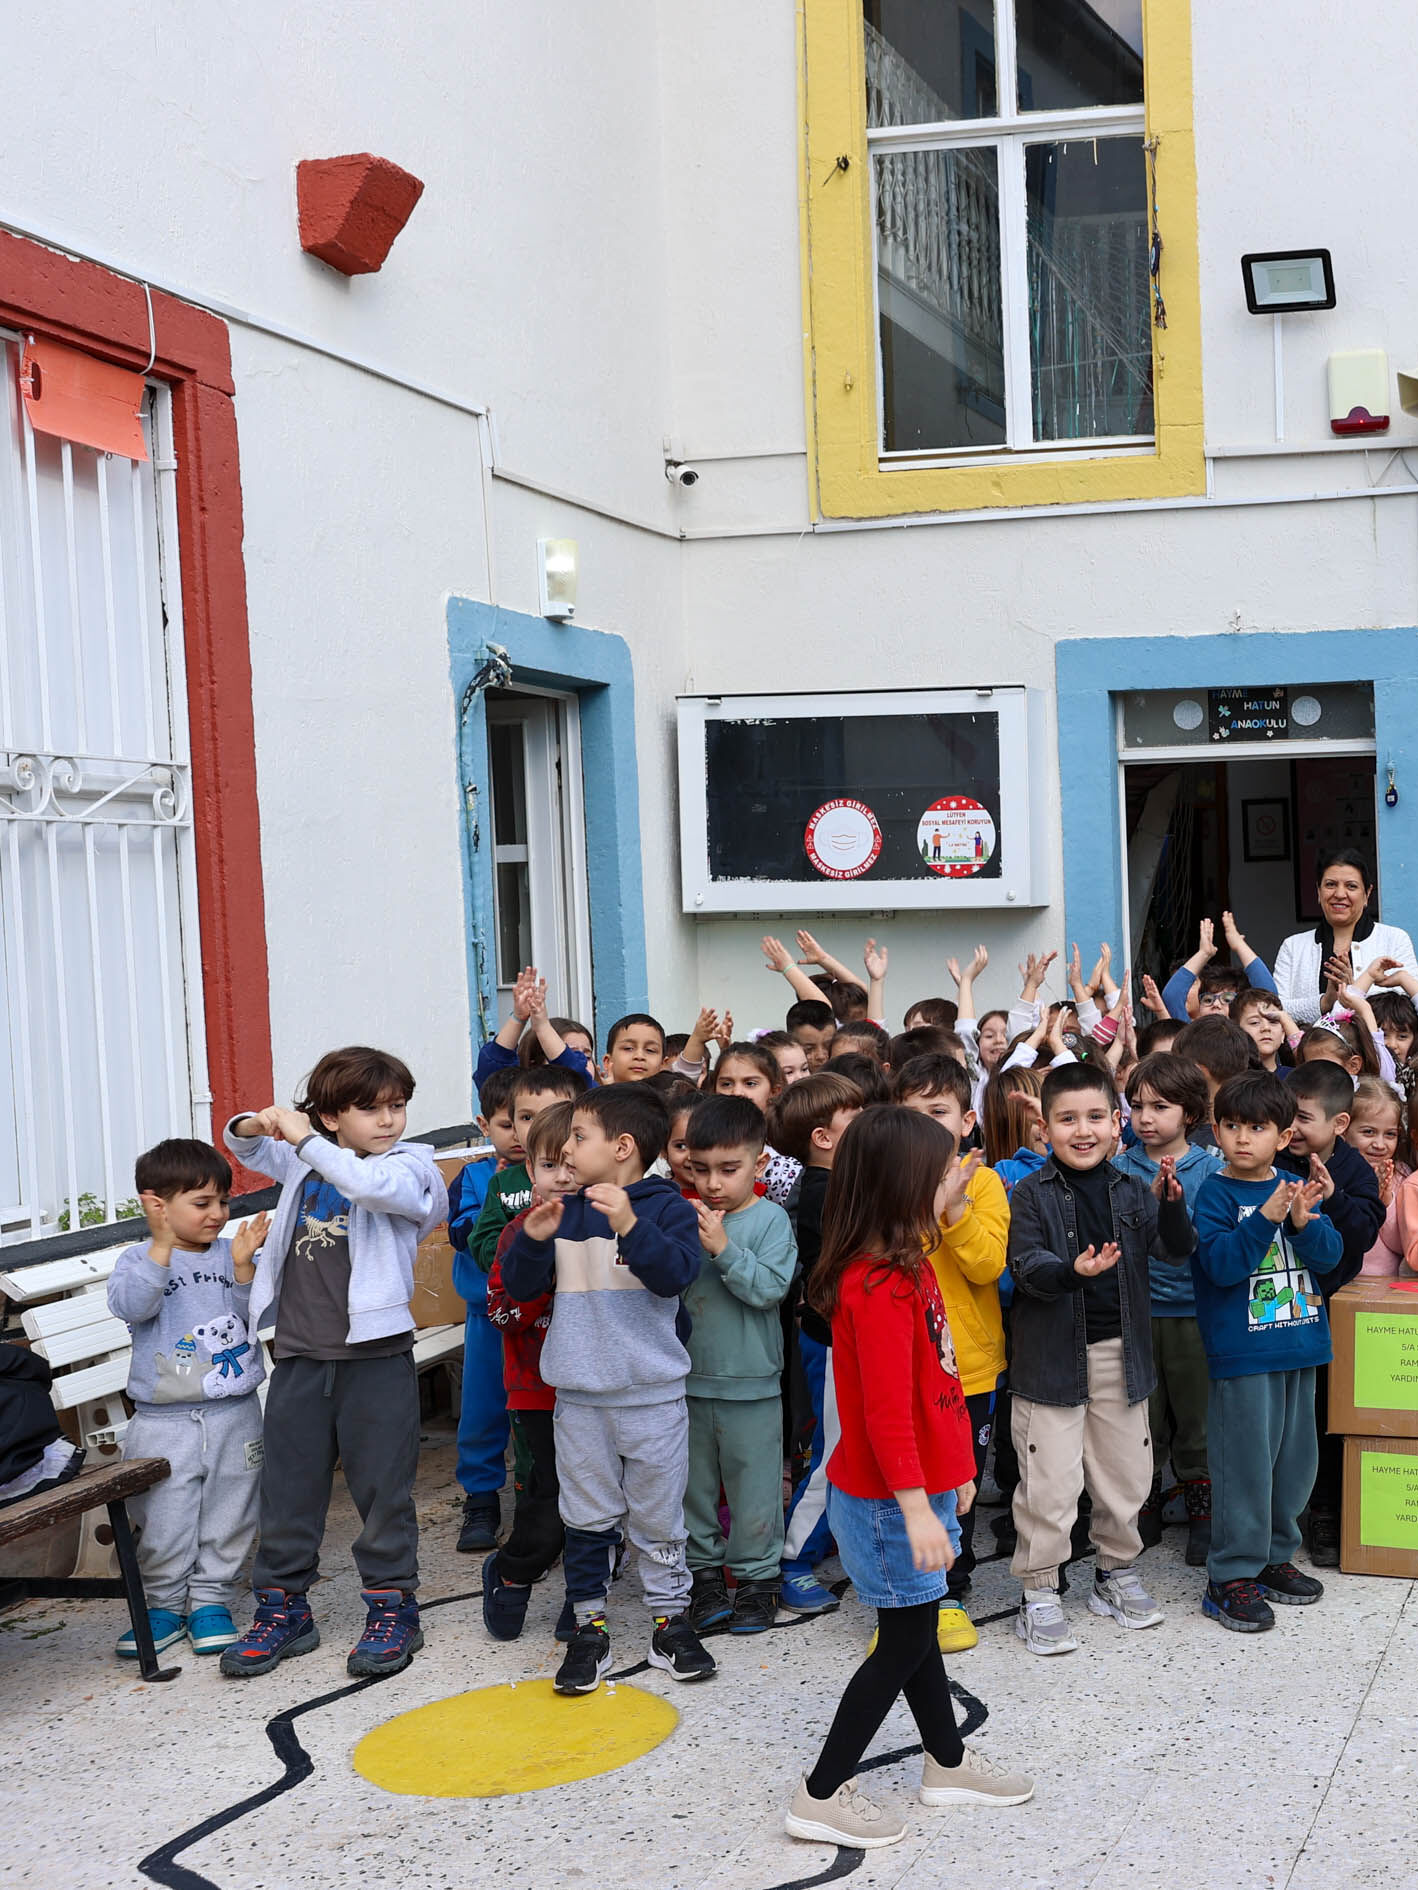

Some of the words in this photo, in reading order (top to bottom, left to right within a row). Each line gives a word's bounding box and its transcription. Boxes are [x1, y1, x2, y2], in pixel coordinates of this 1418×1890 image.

[1212, 688, 1250, 700] HAYME
[1244, 700, 1280, 711] HATUN
[1230, 719, 1287, 730] ANAOKULU
[809, 800, 845, 829] MASKESİZ
[810, 853, 844, 879] MASKESİZ
[845, 853, 878, 879] GİRİLMEZ
[1366, 1326, 1396, 1335] HAYME
[1401, 1343, 1415, 1351] 5/A
[1372, 1465, 1401, 1475] HAYME
